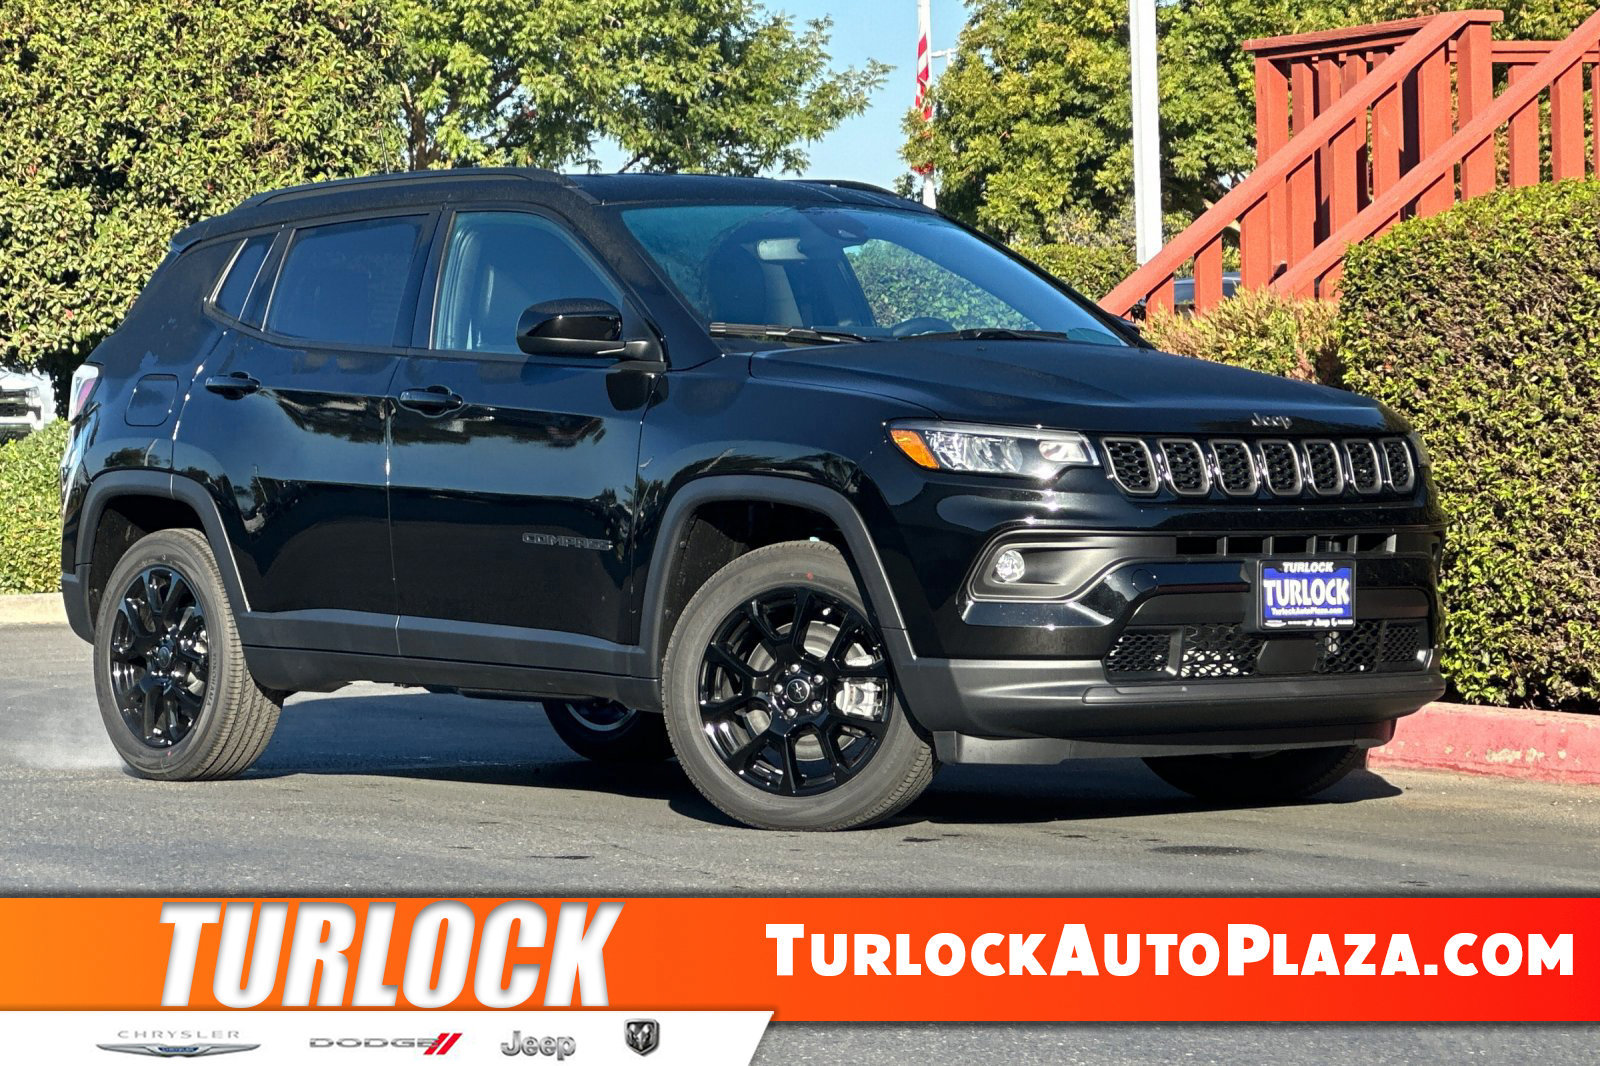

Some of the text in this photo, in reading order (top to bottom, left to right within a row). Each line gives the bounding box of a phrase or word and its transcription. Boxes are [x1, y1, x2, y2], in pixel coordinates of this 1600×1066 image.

[1250, 412, 1293, 430] Jeep
[1282, 561, 1334, 573] TURLOCK
[1263, 578, 1350, 606] TURLOCK
